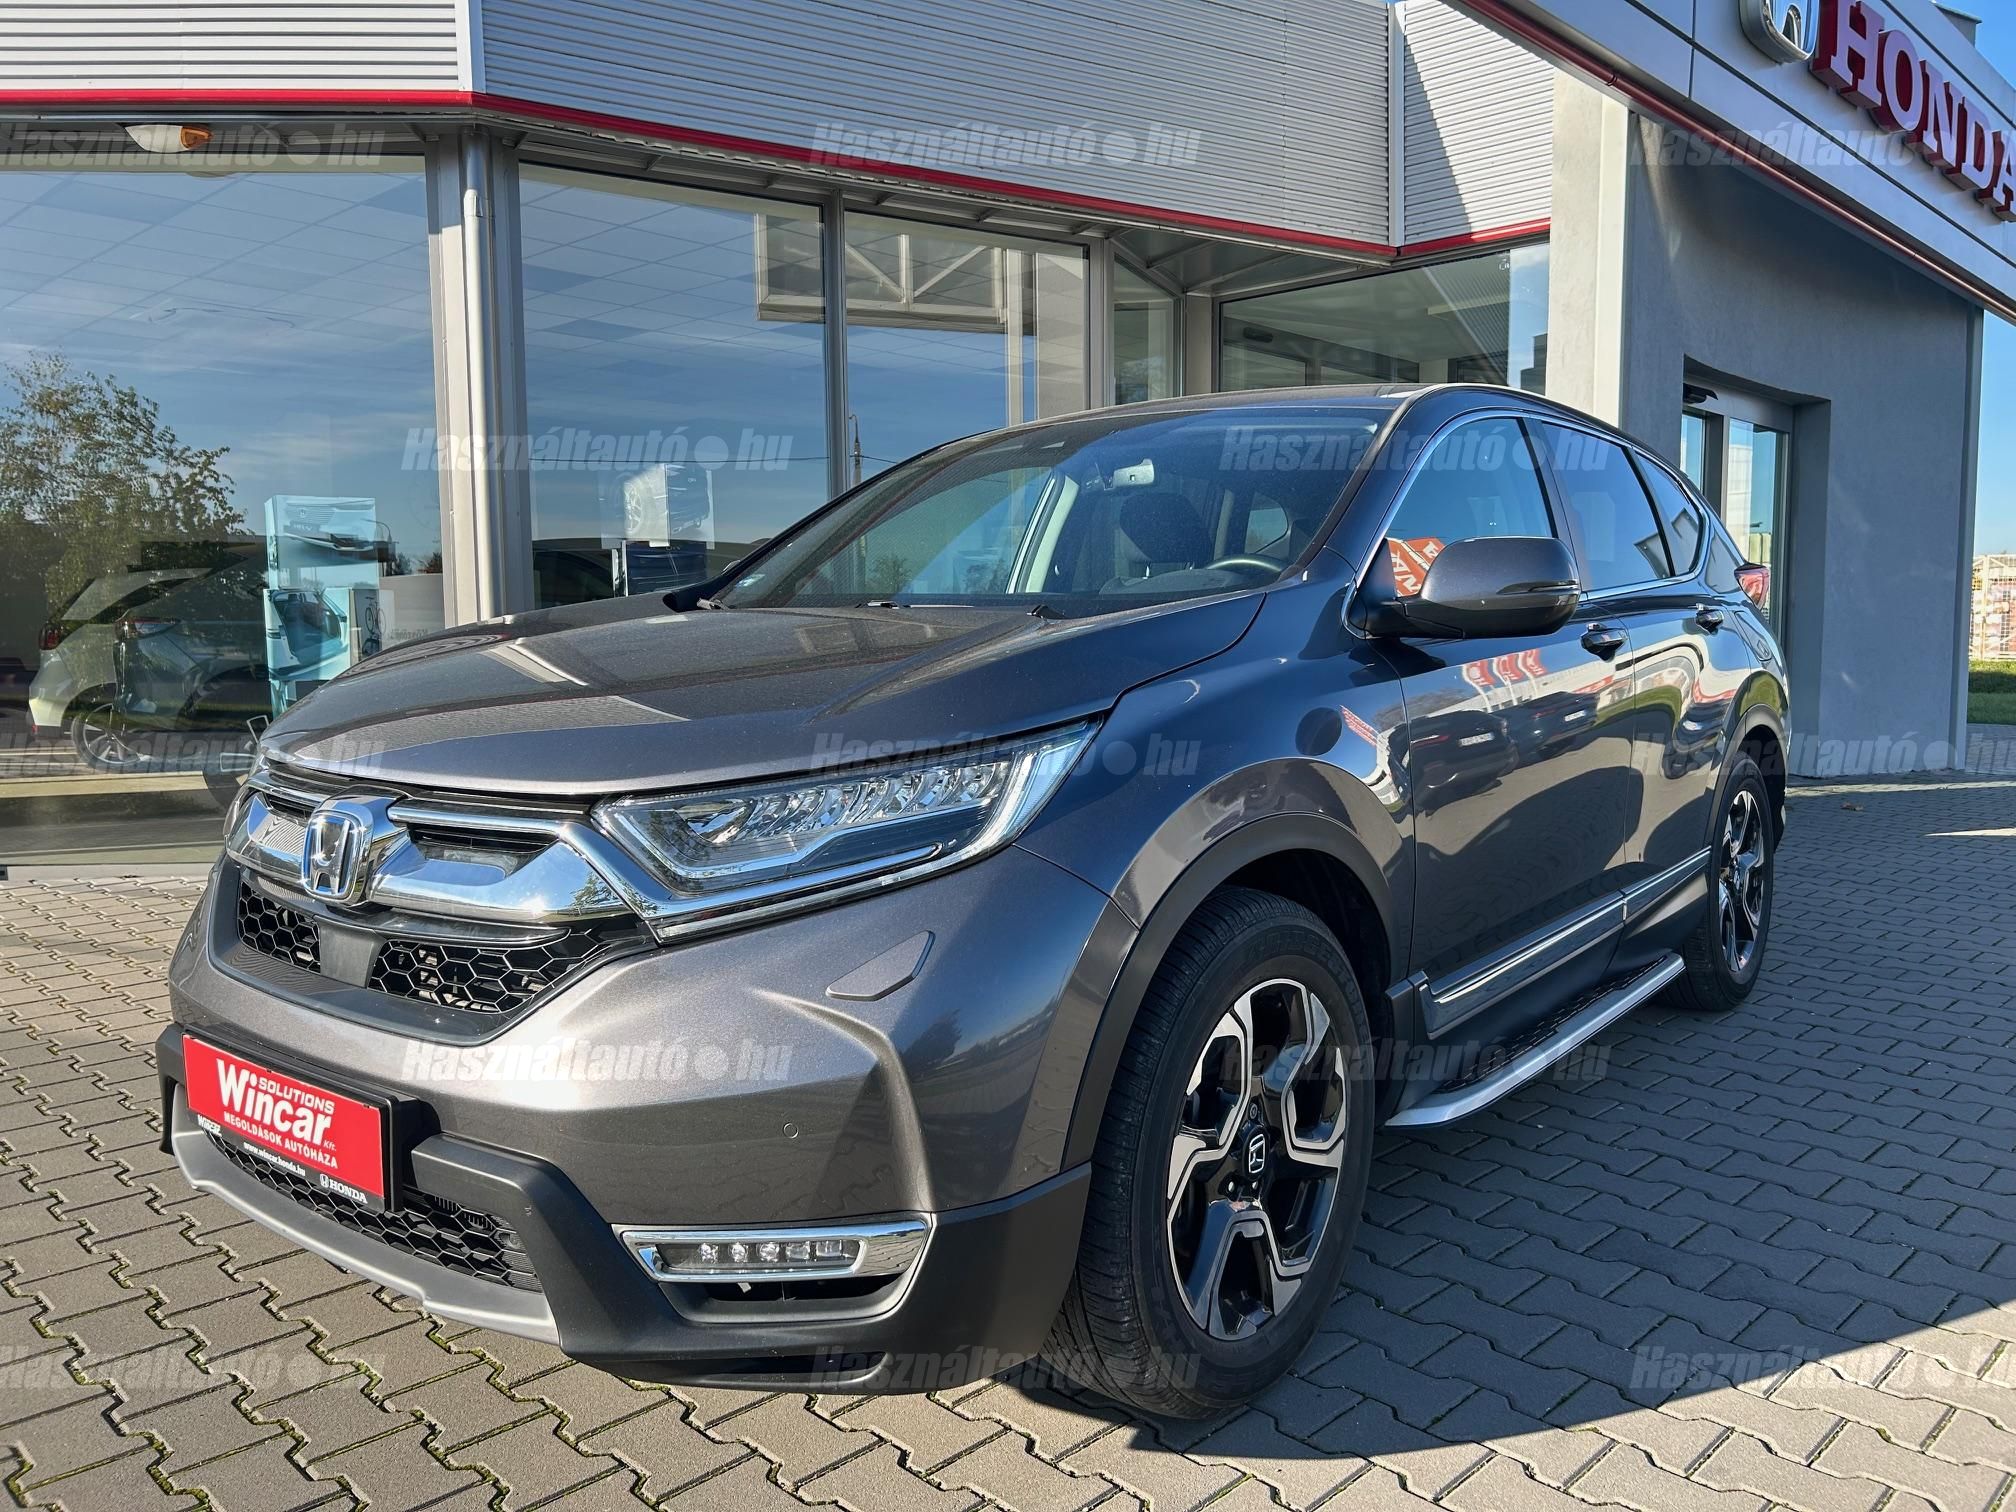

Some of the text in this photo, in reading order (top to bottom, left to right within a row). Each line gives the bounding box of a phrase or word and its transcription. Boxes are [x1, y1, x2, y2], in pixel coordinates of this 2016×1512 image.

[216, 1058, 332, 1146] Wincar
[258, 1077, 335, 1114] SOLUTIONS
[223, 1111, 338, 1169] MEGOLDÁSOK AUTÓHÁZA
[329, 1181, 368, 1204] HONDA
